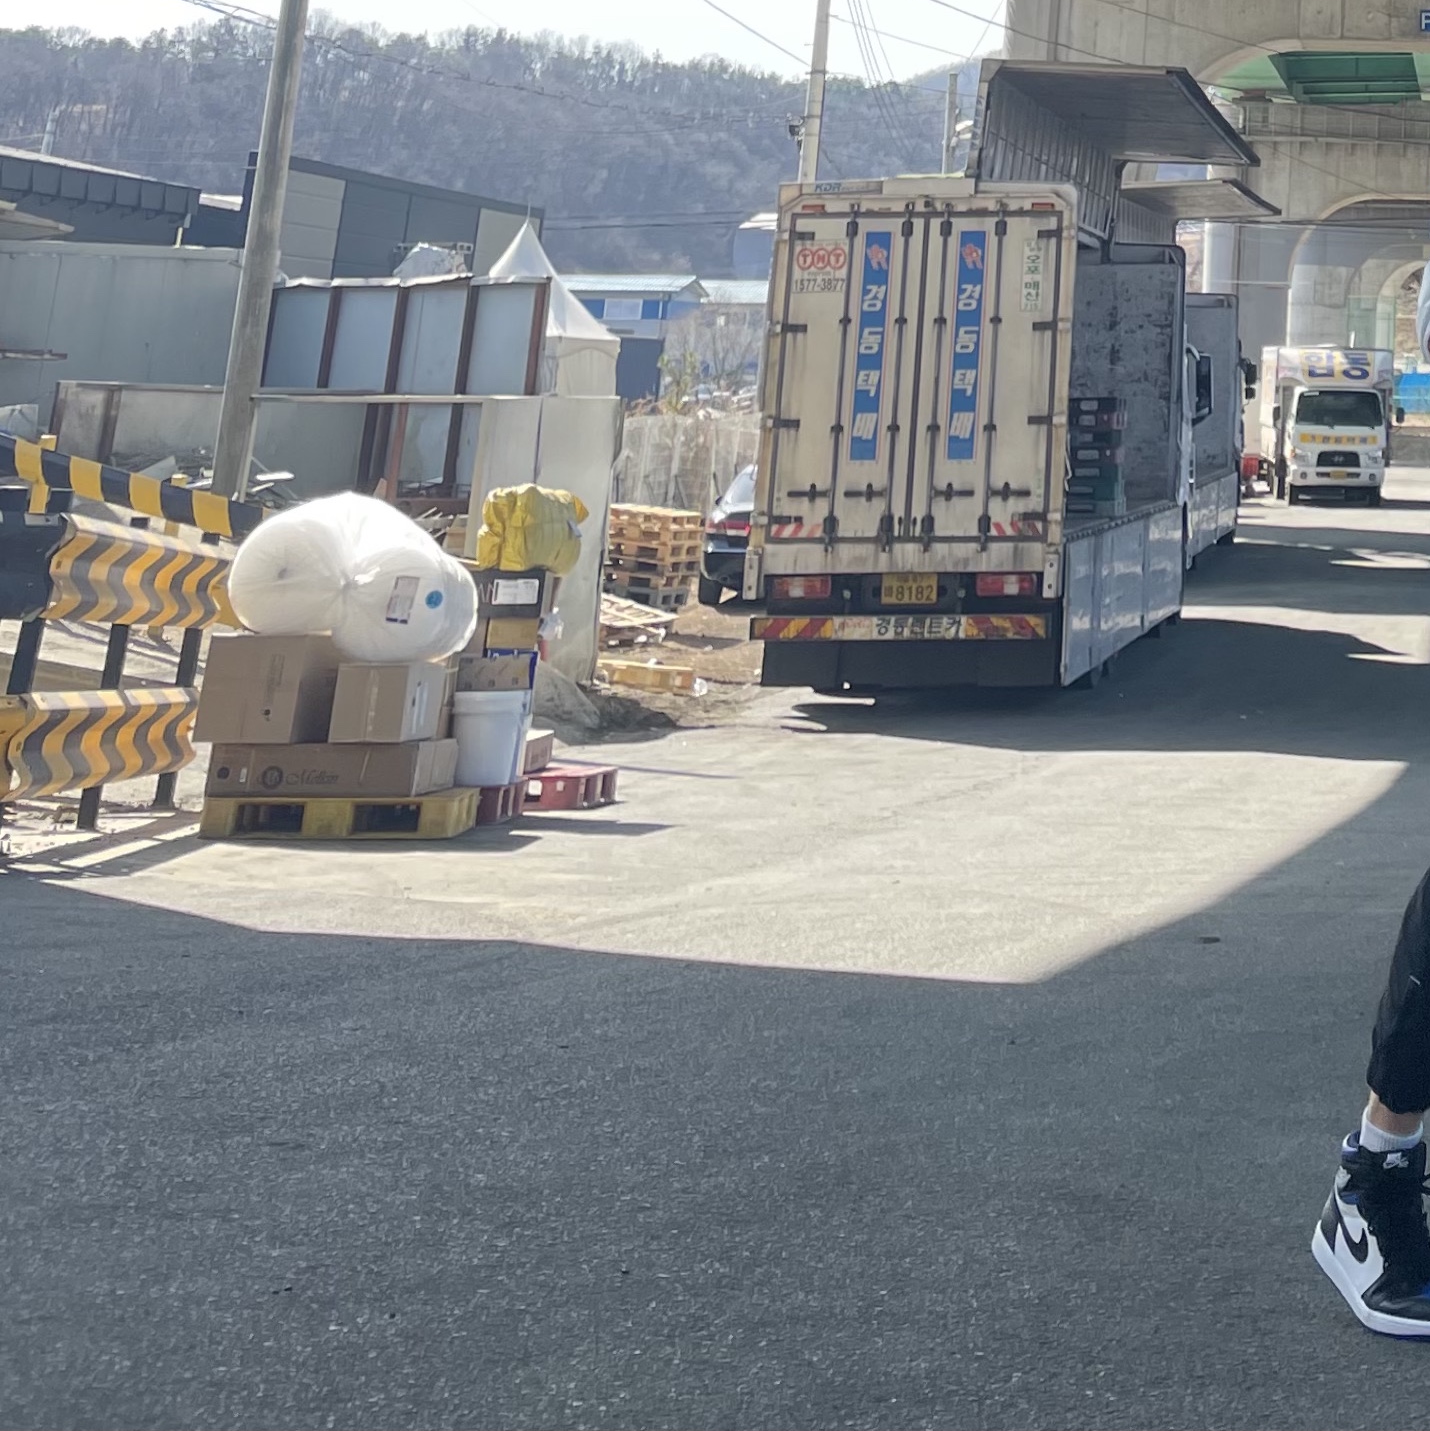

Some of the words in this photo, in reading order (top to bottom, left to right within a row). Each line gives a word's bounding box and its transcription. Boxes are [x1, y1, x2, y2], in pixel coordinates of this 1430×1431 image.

[799, 250, 845, 268] TNT
[794, 278, 845, 292] 1577-3877
[852, 284, 887, 440] 경동택배
[949, 283, 982, 440] 경동택배
[895, 584, 935, 601] 8182
